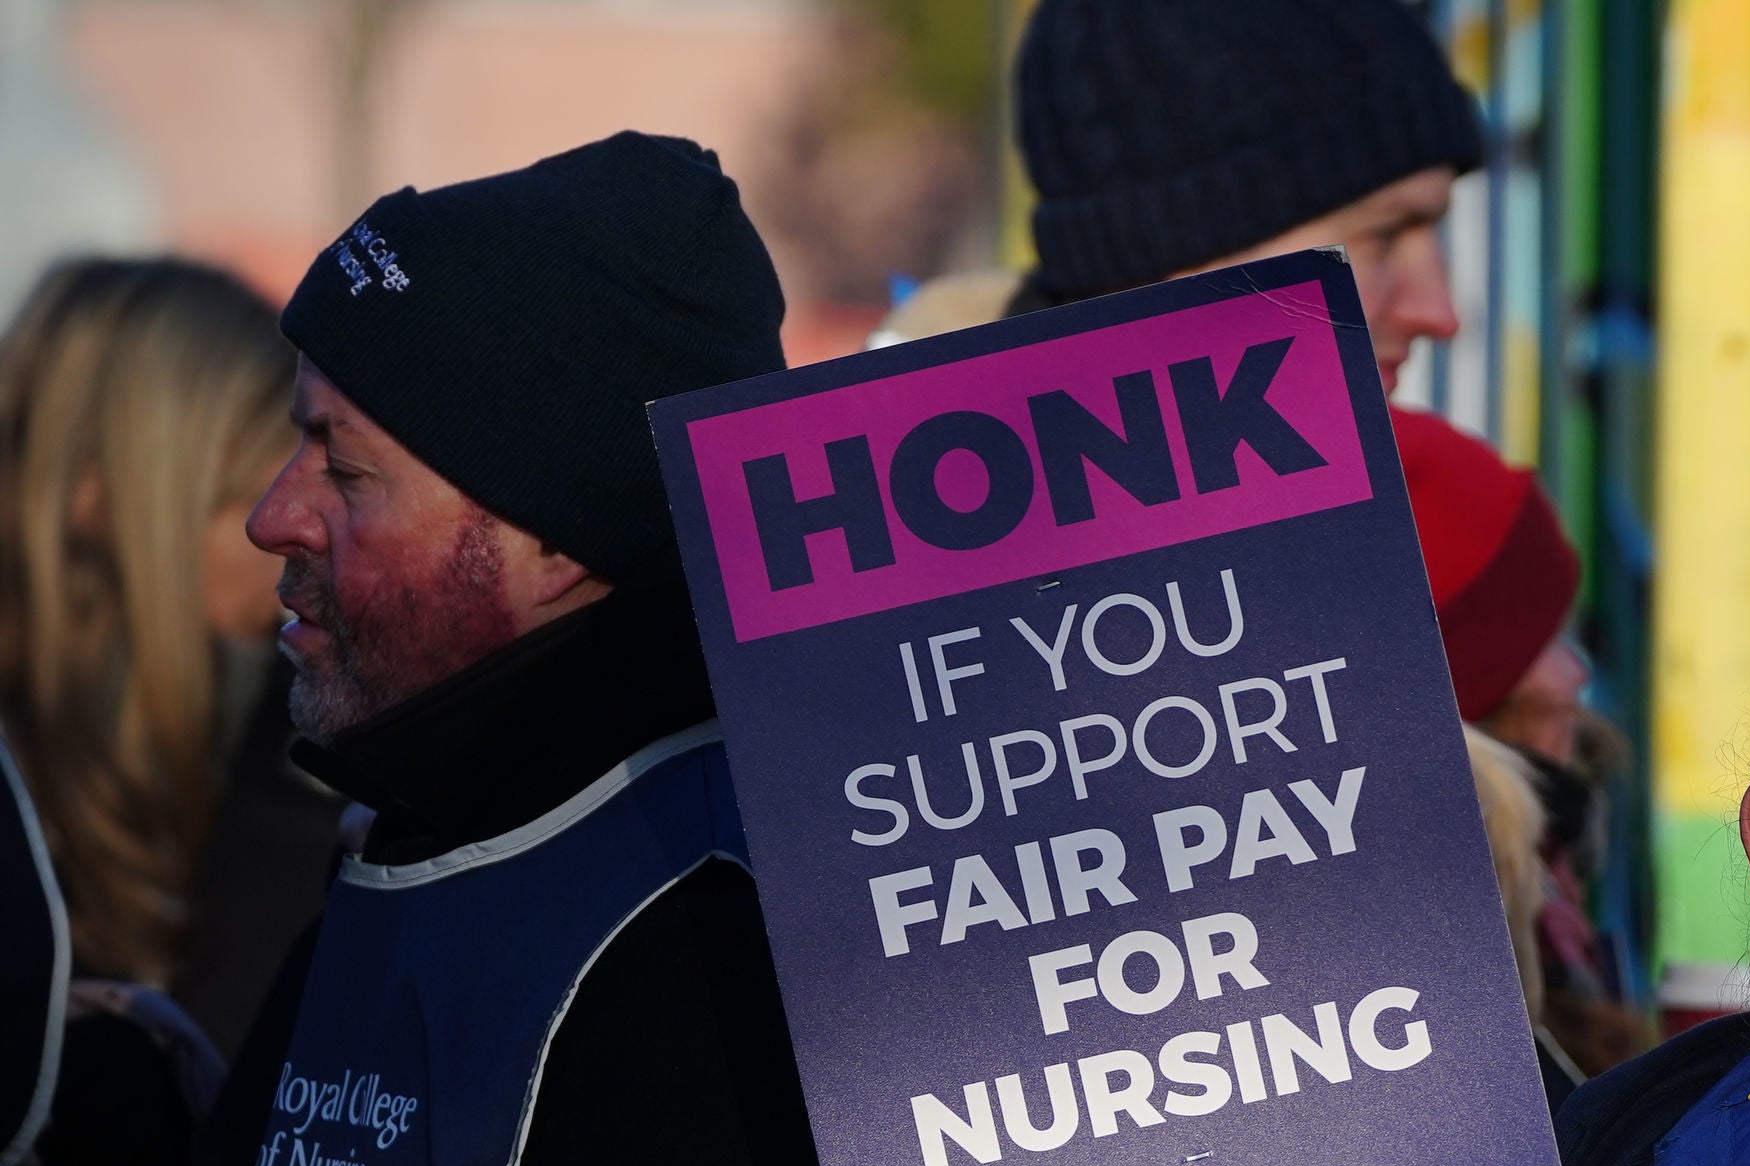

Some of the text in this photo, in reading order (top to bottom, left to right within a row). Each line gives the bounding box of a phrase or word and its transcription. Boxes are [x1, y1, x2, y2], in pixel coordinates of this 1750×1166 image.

[741, 336, 1329, 591] HONK
[899, 568, 1245, 723] IF YOU
[844, 658, 1348, 847] SUPPORT
[868, 766, 1367, 958] FAIR PAY
[1028, 911, 1270, 1035] FOR
